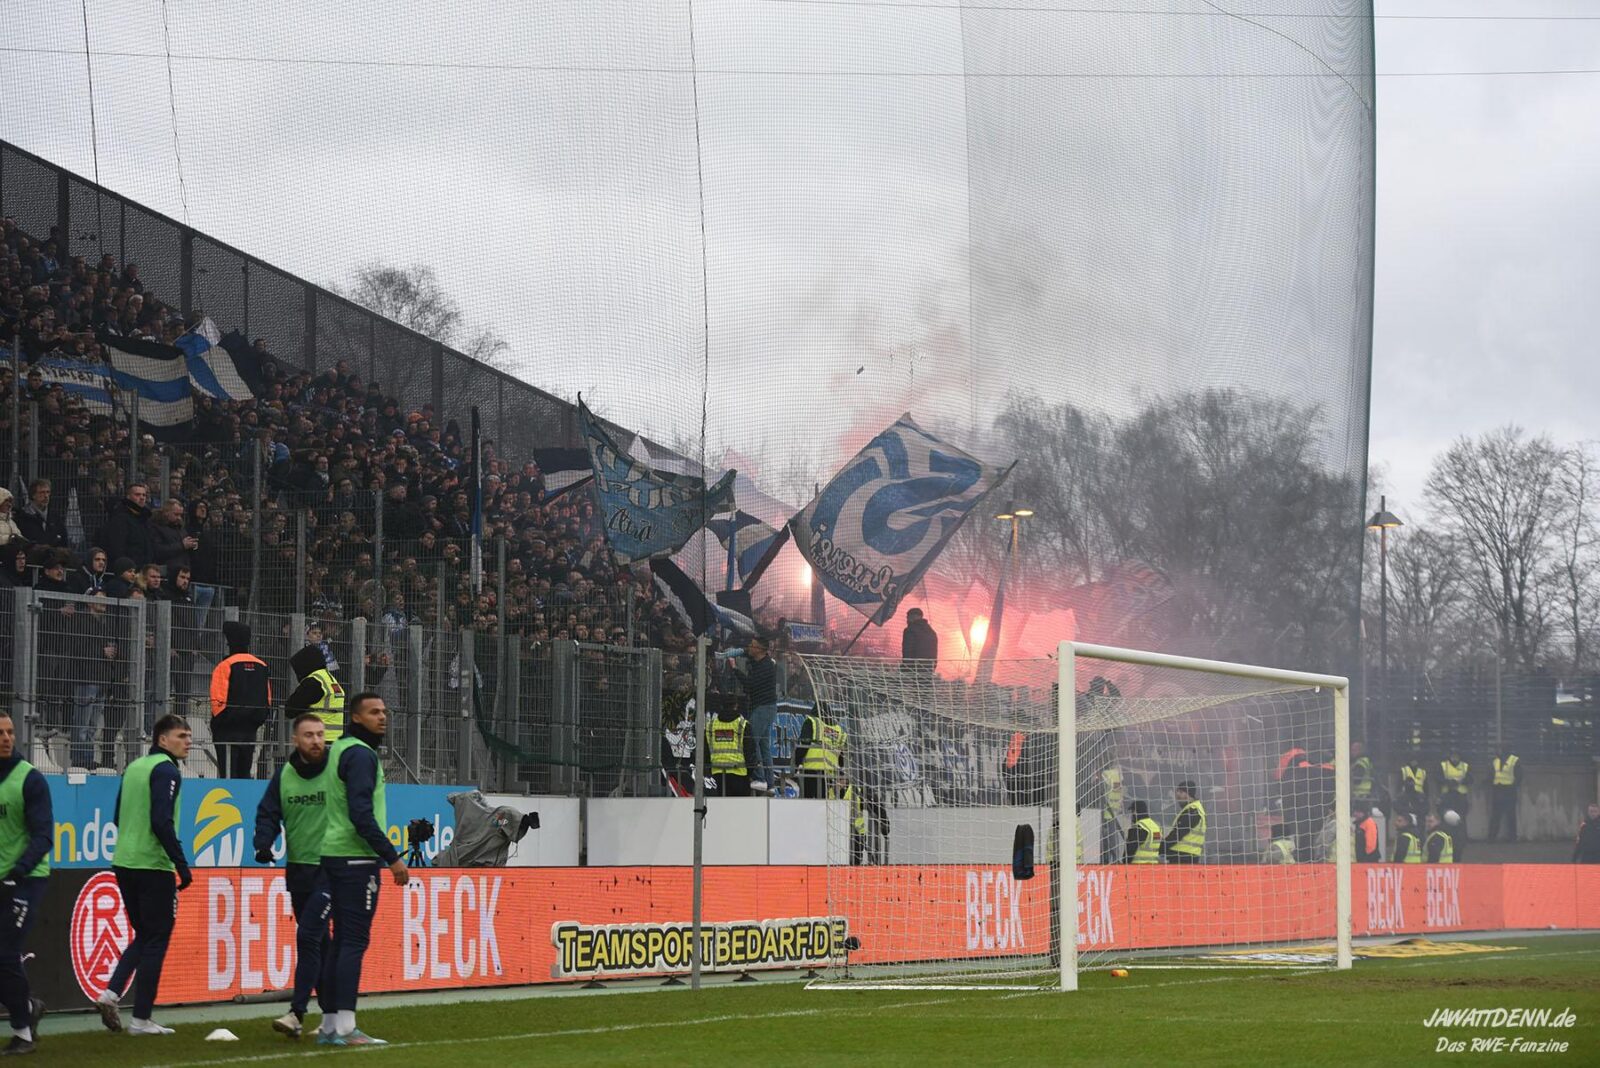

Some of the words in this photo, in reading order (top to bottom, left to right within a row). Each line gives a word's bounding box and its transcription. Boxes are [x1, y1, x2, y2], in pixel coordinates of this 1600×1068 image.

[54, 808, 119, 863] n.de
[208, 876, 298, 991] BEC
[403, 875, 503, 980] BECK
[966, 870, 1025, 950] BECK
[1077, 870, 1115, 944] ECK
[1367, 867, 1405, 929] BECK
[1427, 868, 1461, 927] BECK
